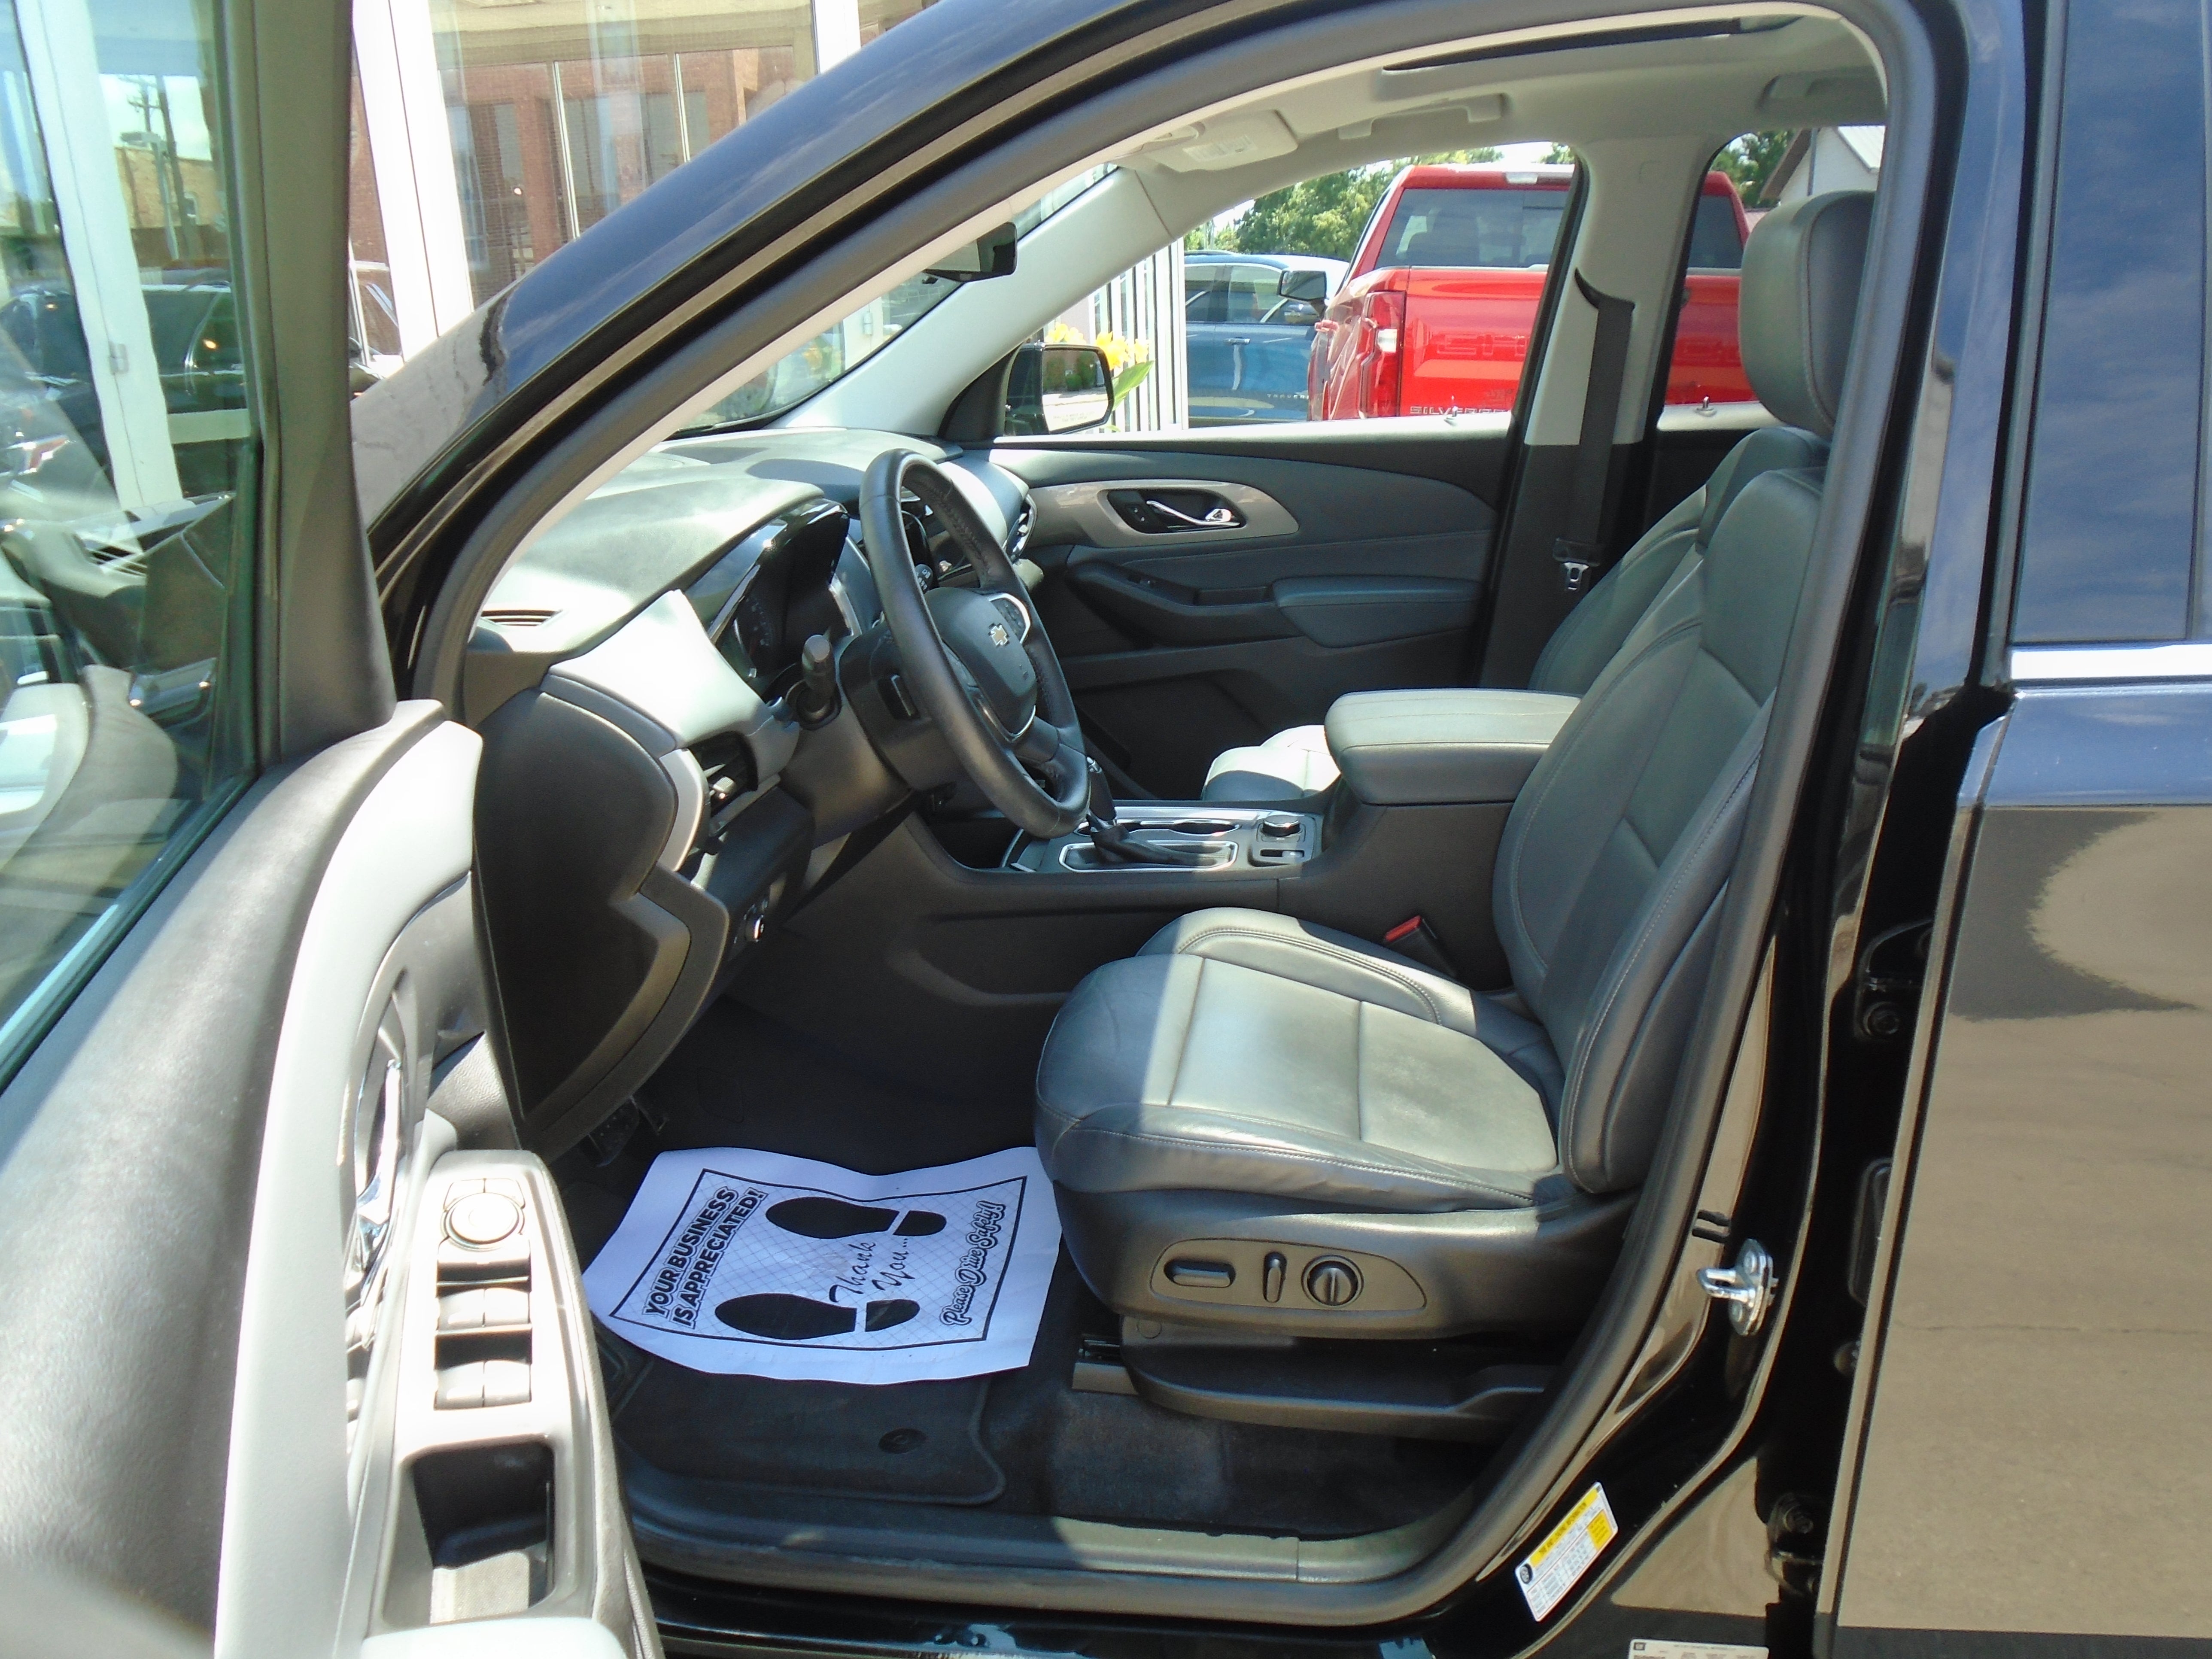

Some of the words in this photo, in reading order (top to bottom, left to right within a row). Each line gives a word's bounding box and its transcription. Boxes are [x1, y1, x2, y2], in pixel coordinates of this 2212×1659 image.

[1410, 405, 1511, 415] SILVERA
[678, 1188, 766, 1310] APPRECIATED!
[966, 1200, 1005, 1249] Safely!
[644, 1268, 682, 1317] YOUR
[666, 1187, 737, 1270] BUSINESS
[829, 1242, 876, 1303] Thank
[871, 1238, 915, 1291] You...
[956, 1247, 985, 1286] Drive
[671, 1307, 695, 1328] IS
[941, 1285, 973, 1326] Please
